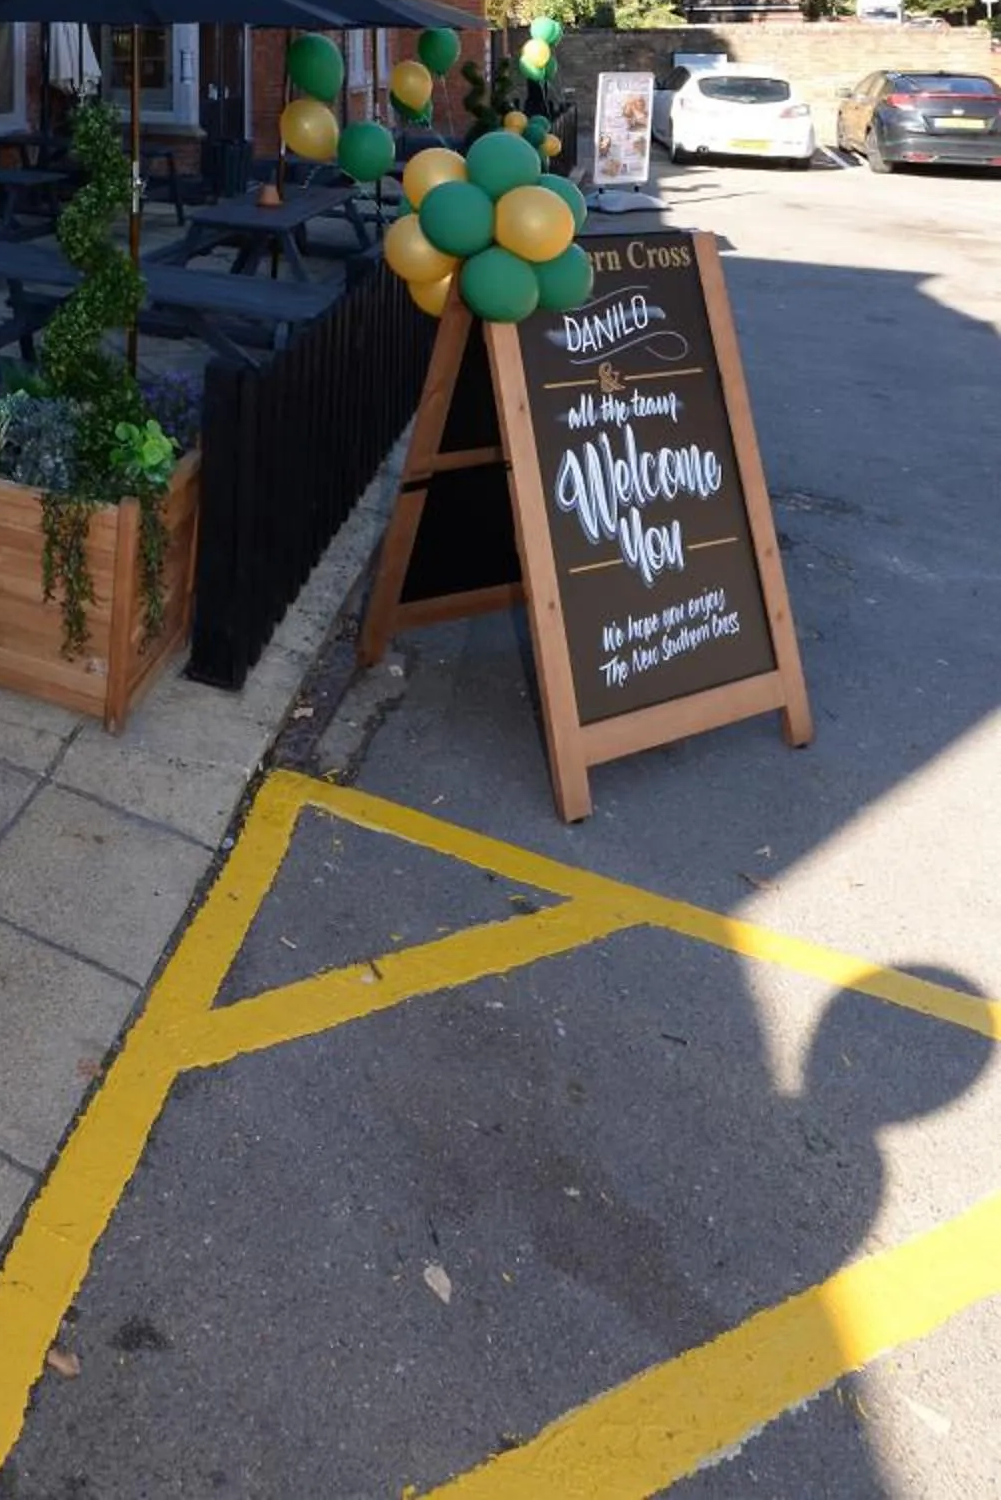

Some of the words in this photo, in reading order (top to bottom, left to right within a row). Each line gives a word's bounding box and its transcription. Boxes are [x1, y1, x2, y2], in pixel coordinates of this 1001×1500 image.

[626, 241, 691, 269] Cross
[562, 294, 649, 353] DANILO
[599, 361, 626, 393] &
[568, 393, 597, 430] all
[600, 393, 629, 428] the
[630, 387, 679, 424] team
[555, 422, 723, 545] Welcome
[602, 620, 625, 652] We
[627, 613, 660, 642] hope
[661, 603, 685, 633] you
[687, 587, 727, 621] enjoy
[599, 654, 630, 688] The
[631, 645, 660, 675] New
[661, 624, 711, 661] Southern
[711, 611, 740, 638] Cross
